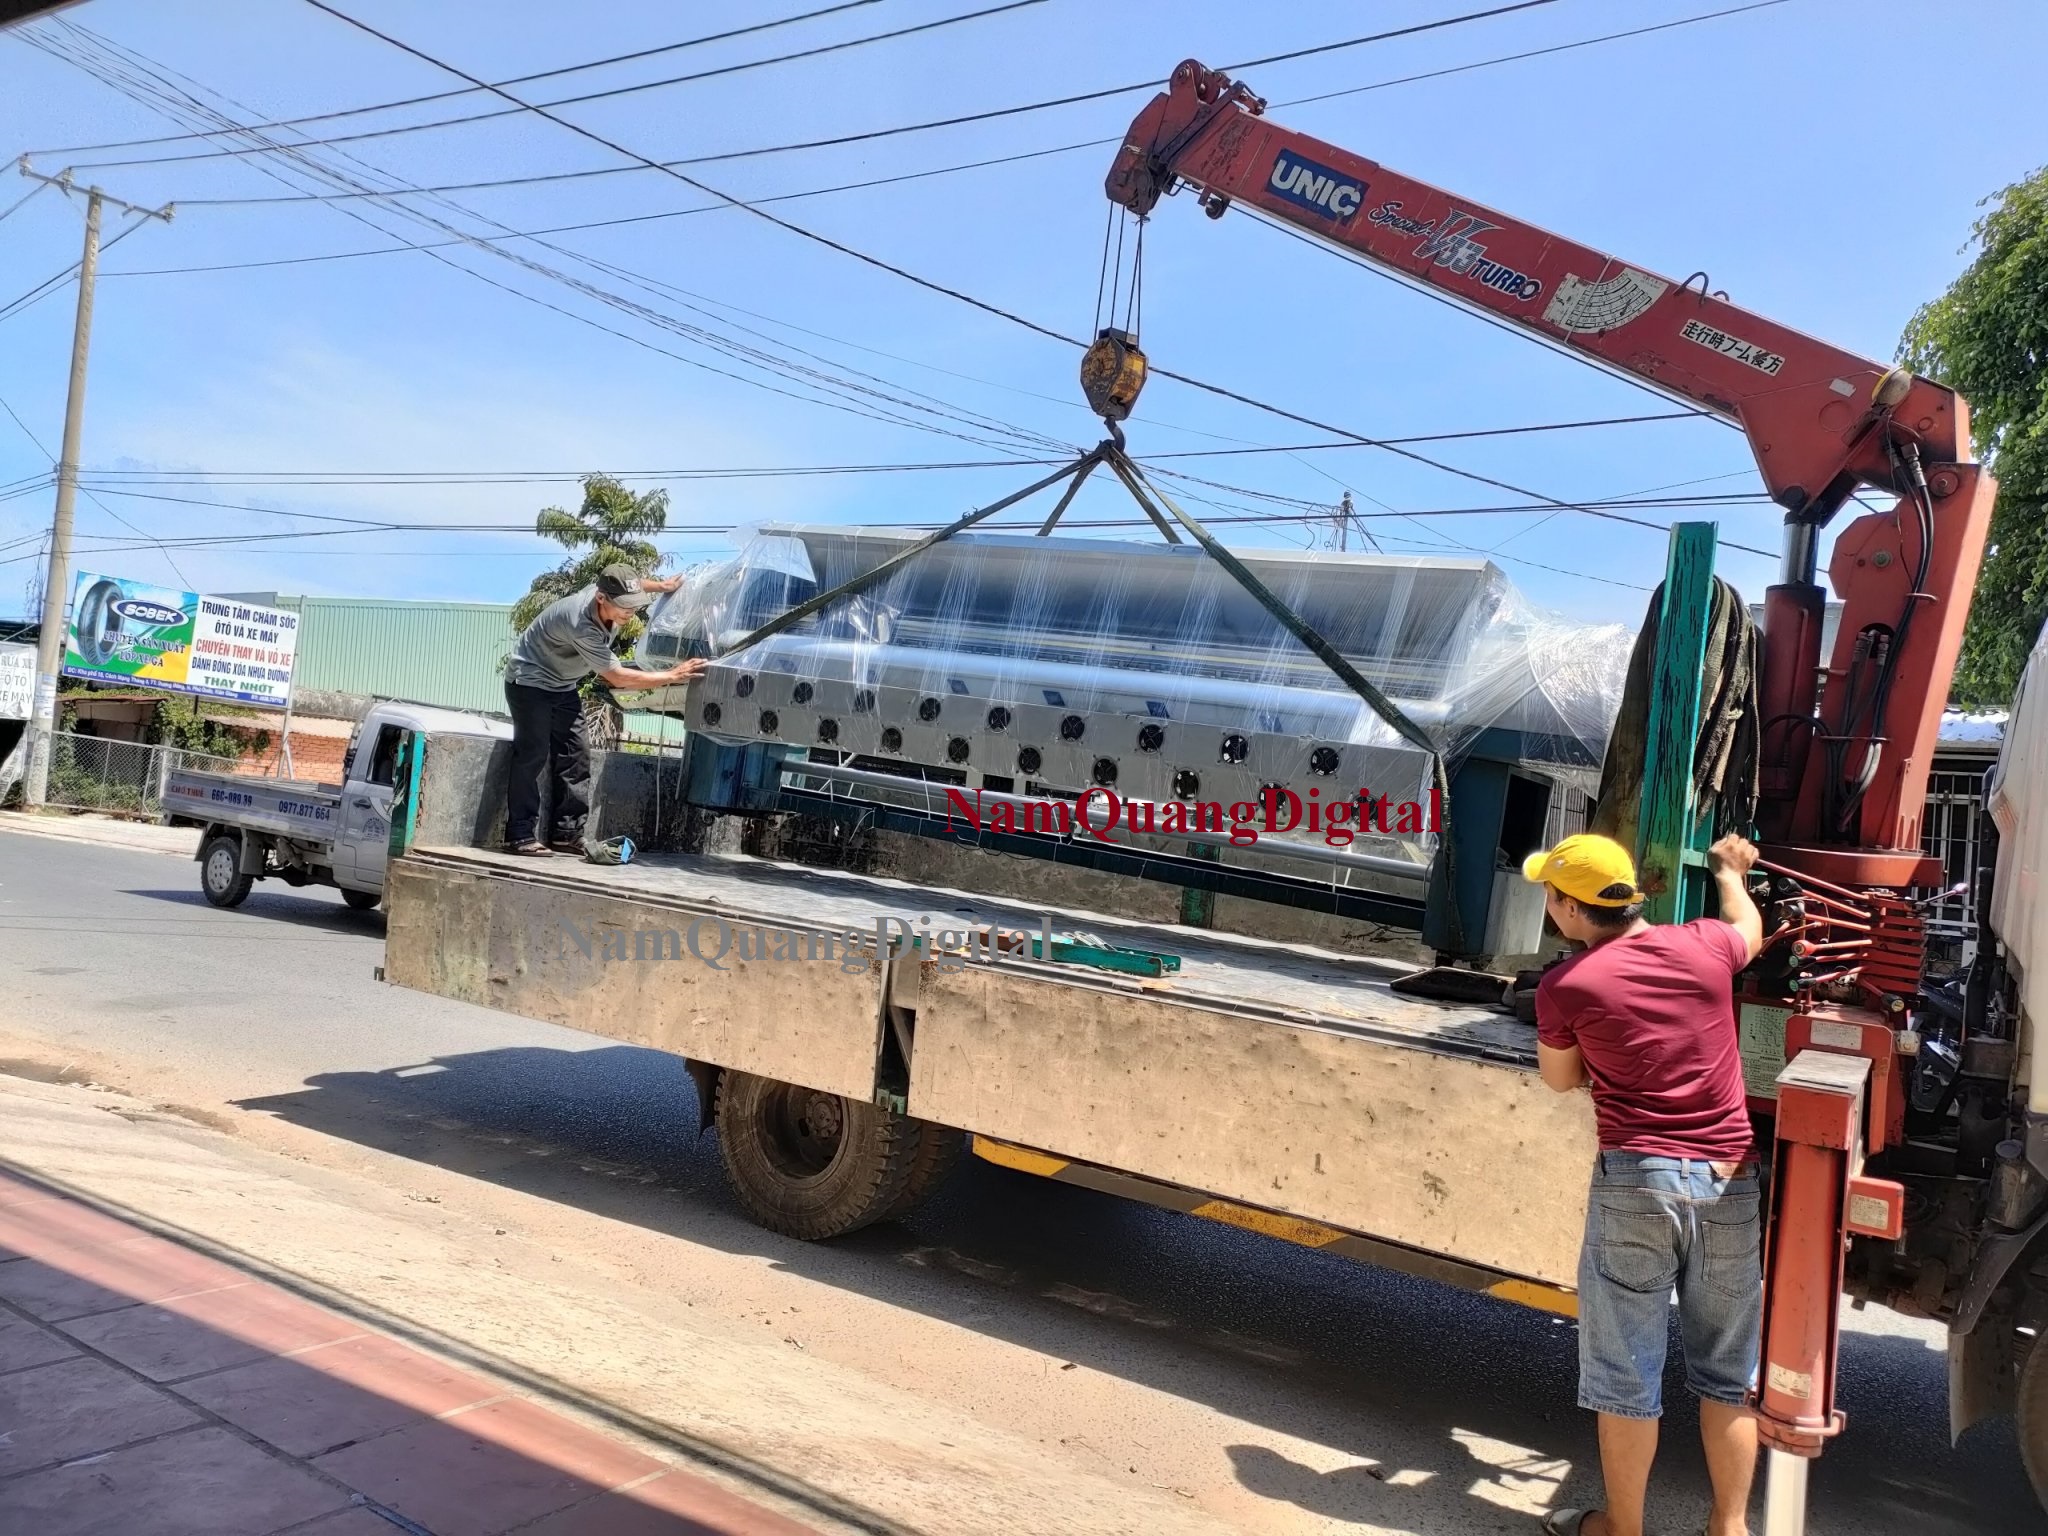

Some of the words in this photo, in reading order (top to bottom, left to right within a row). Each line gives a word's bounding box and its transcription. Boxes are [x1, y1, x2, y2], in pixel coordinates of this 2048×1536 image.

[1271, 159, 1361, 217] UNIC
[1469, 256, 1542, 301] TURBO
[124, 604, 178, 623] SOBEK
[201, 601, 230, 617] TRUNG
[232, 606, 251, 622] TÂM
[252, 610, 278, 627] CHĂM
[279, 615, 297, 630] SÓC
[103, 630, 140, 646] CHUYÊN
[214, 619, 232, 636] ÔTÔ
[246, 627, 258, 640] XE
[259, 629, 279, 644] MÁY
[151, 655, 164, 667] GA
[195, 638, 231, 656] CHUYÊN
[232, 645, 253, 660] THAY
[279, 653, 291, 666] XE
[192, 655, 211, 671] ĐÁNH
[212, 659, 232, 674] BÓNG
[203, 676, 236, 689] THAY
[240, 681, 274, 694] NHỚT
[278, 800, 314, 819] 0977.877
[315, 806, 330, 821] 664
